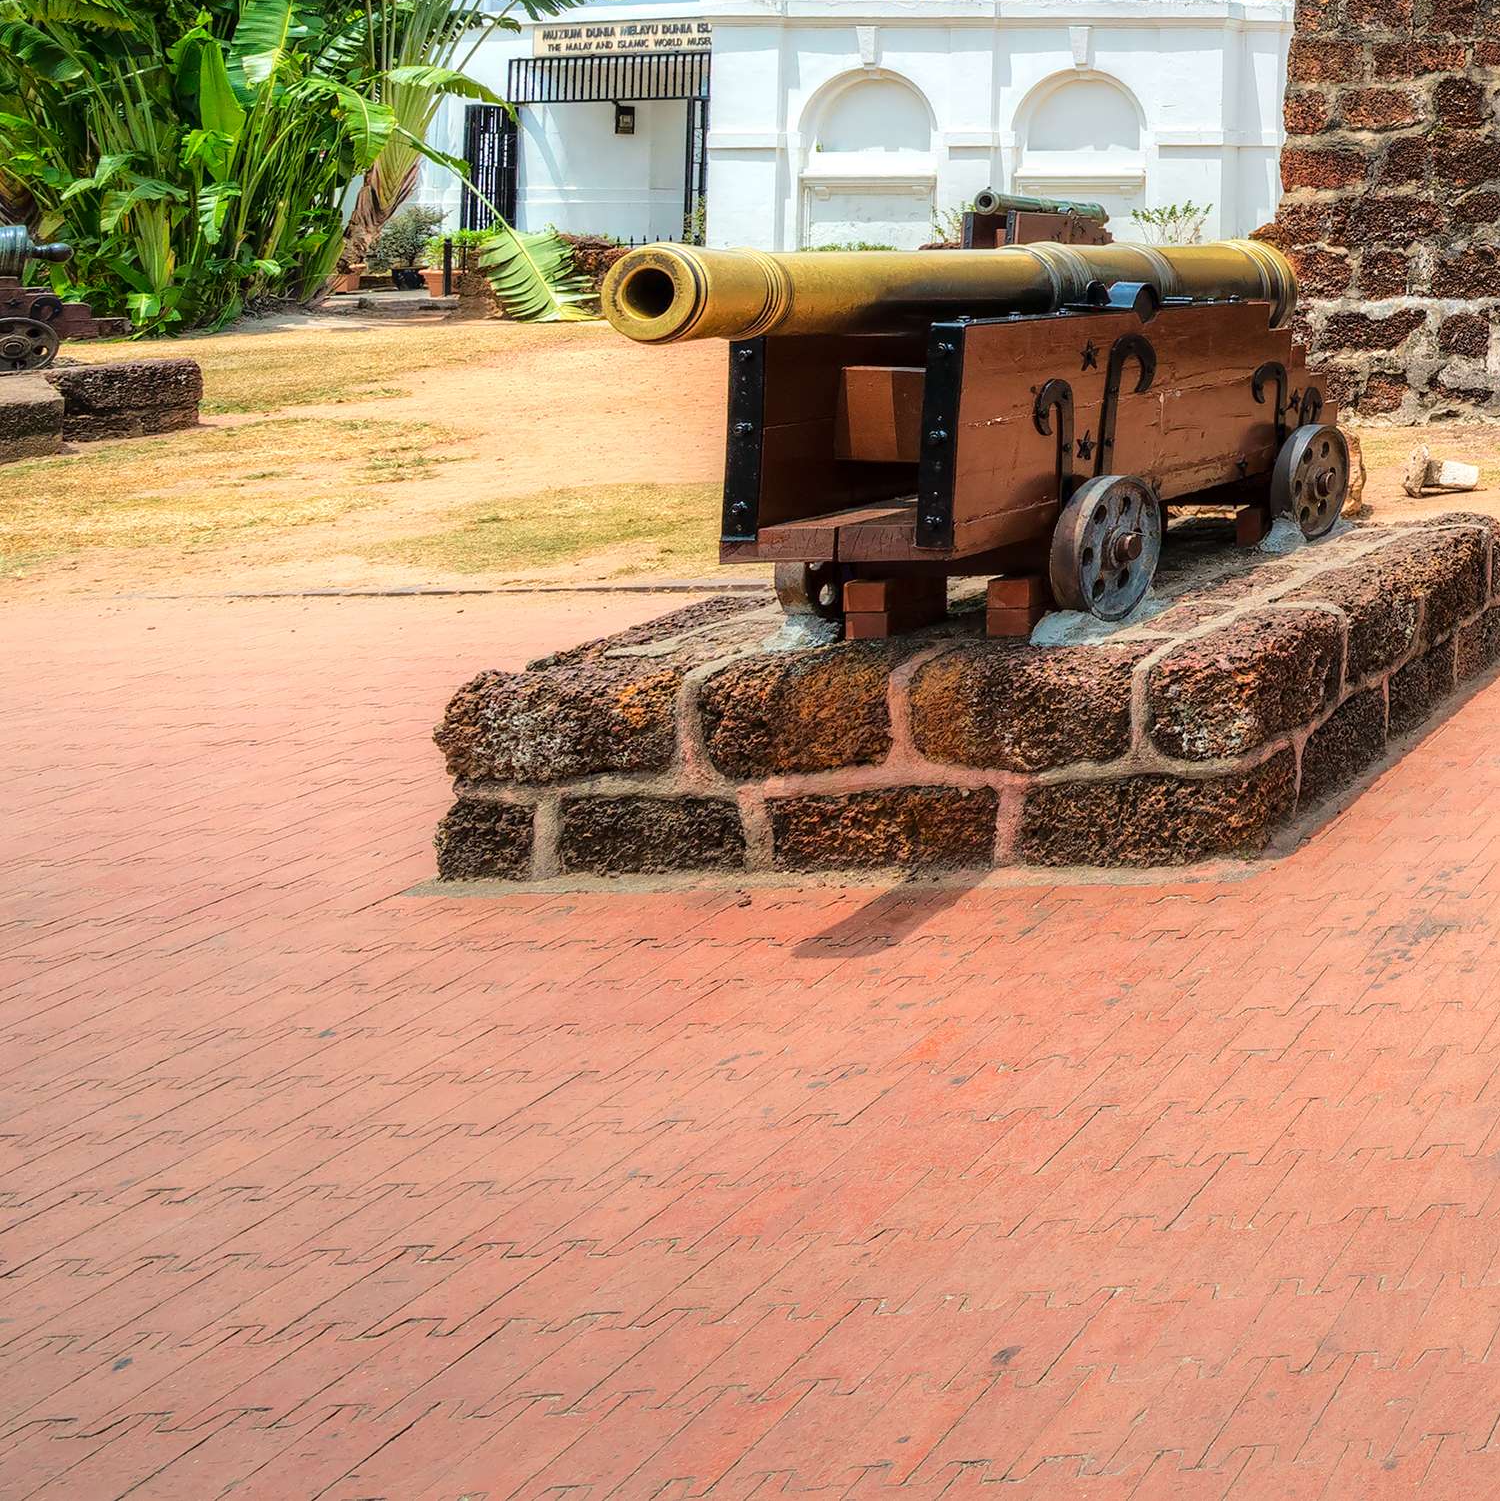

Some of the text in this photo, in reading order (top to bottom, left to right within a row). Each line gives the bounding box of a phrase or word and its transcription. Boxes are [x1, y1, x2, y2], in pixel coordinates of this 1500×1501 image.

[543, 22, 712, 40] MUZIUM DUNIA MELAYU DUNIA ISL
[547, 43, 561, 52] THE
[565, 42, 592, 51] MALAY
[595, 40, 613, 50] AND
[618, 39, 649, 48] ISLAMIC
[654, 37, 683, 47] WORLD
